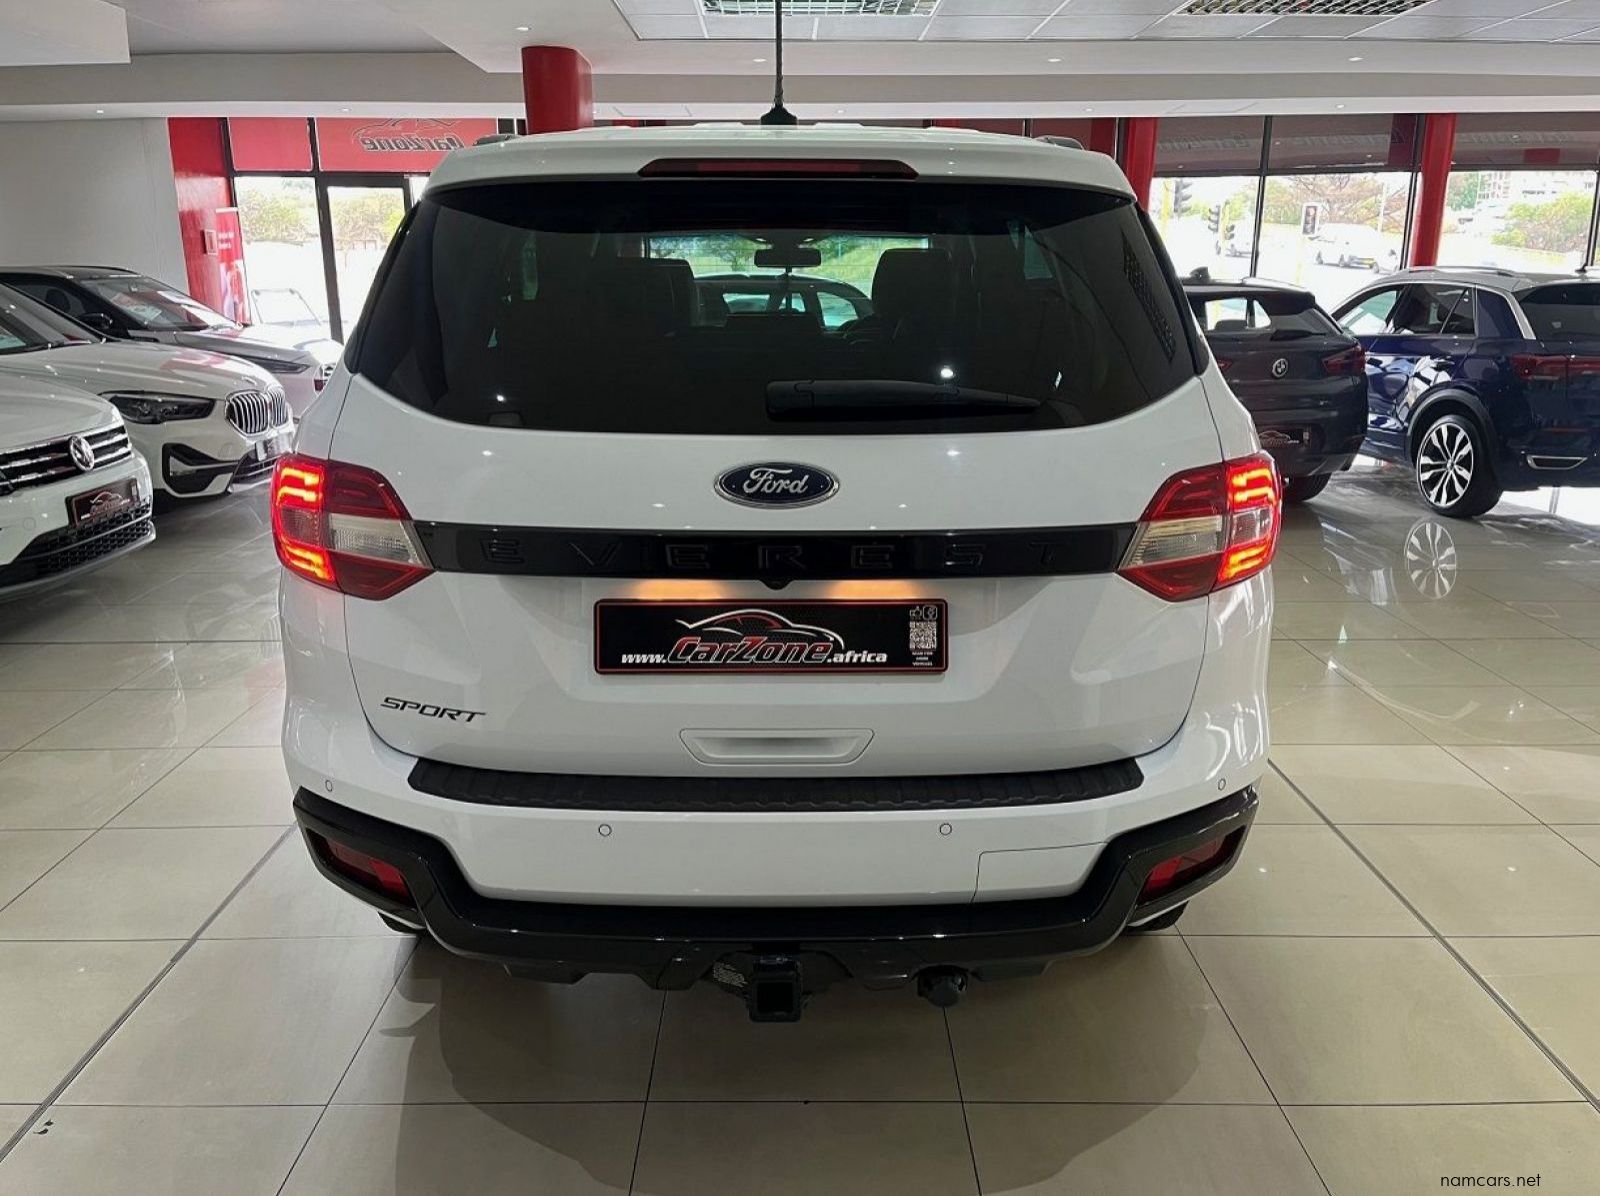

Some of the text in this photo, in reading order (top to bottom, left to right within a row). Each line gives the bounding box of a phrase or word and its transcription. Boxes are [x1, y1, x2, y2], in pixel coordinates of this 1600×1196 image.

[742, 467, 809, 493] Ford
[480, 538, 1066, 570] EVEREST
[380, 697, 486, 722] SPORT
